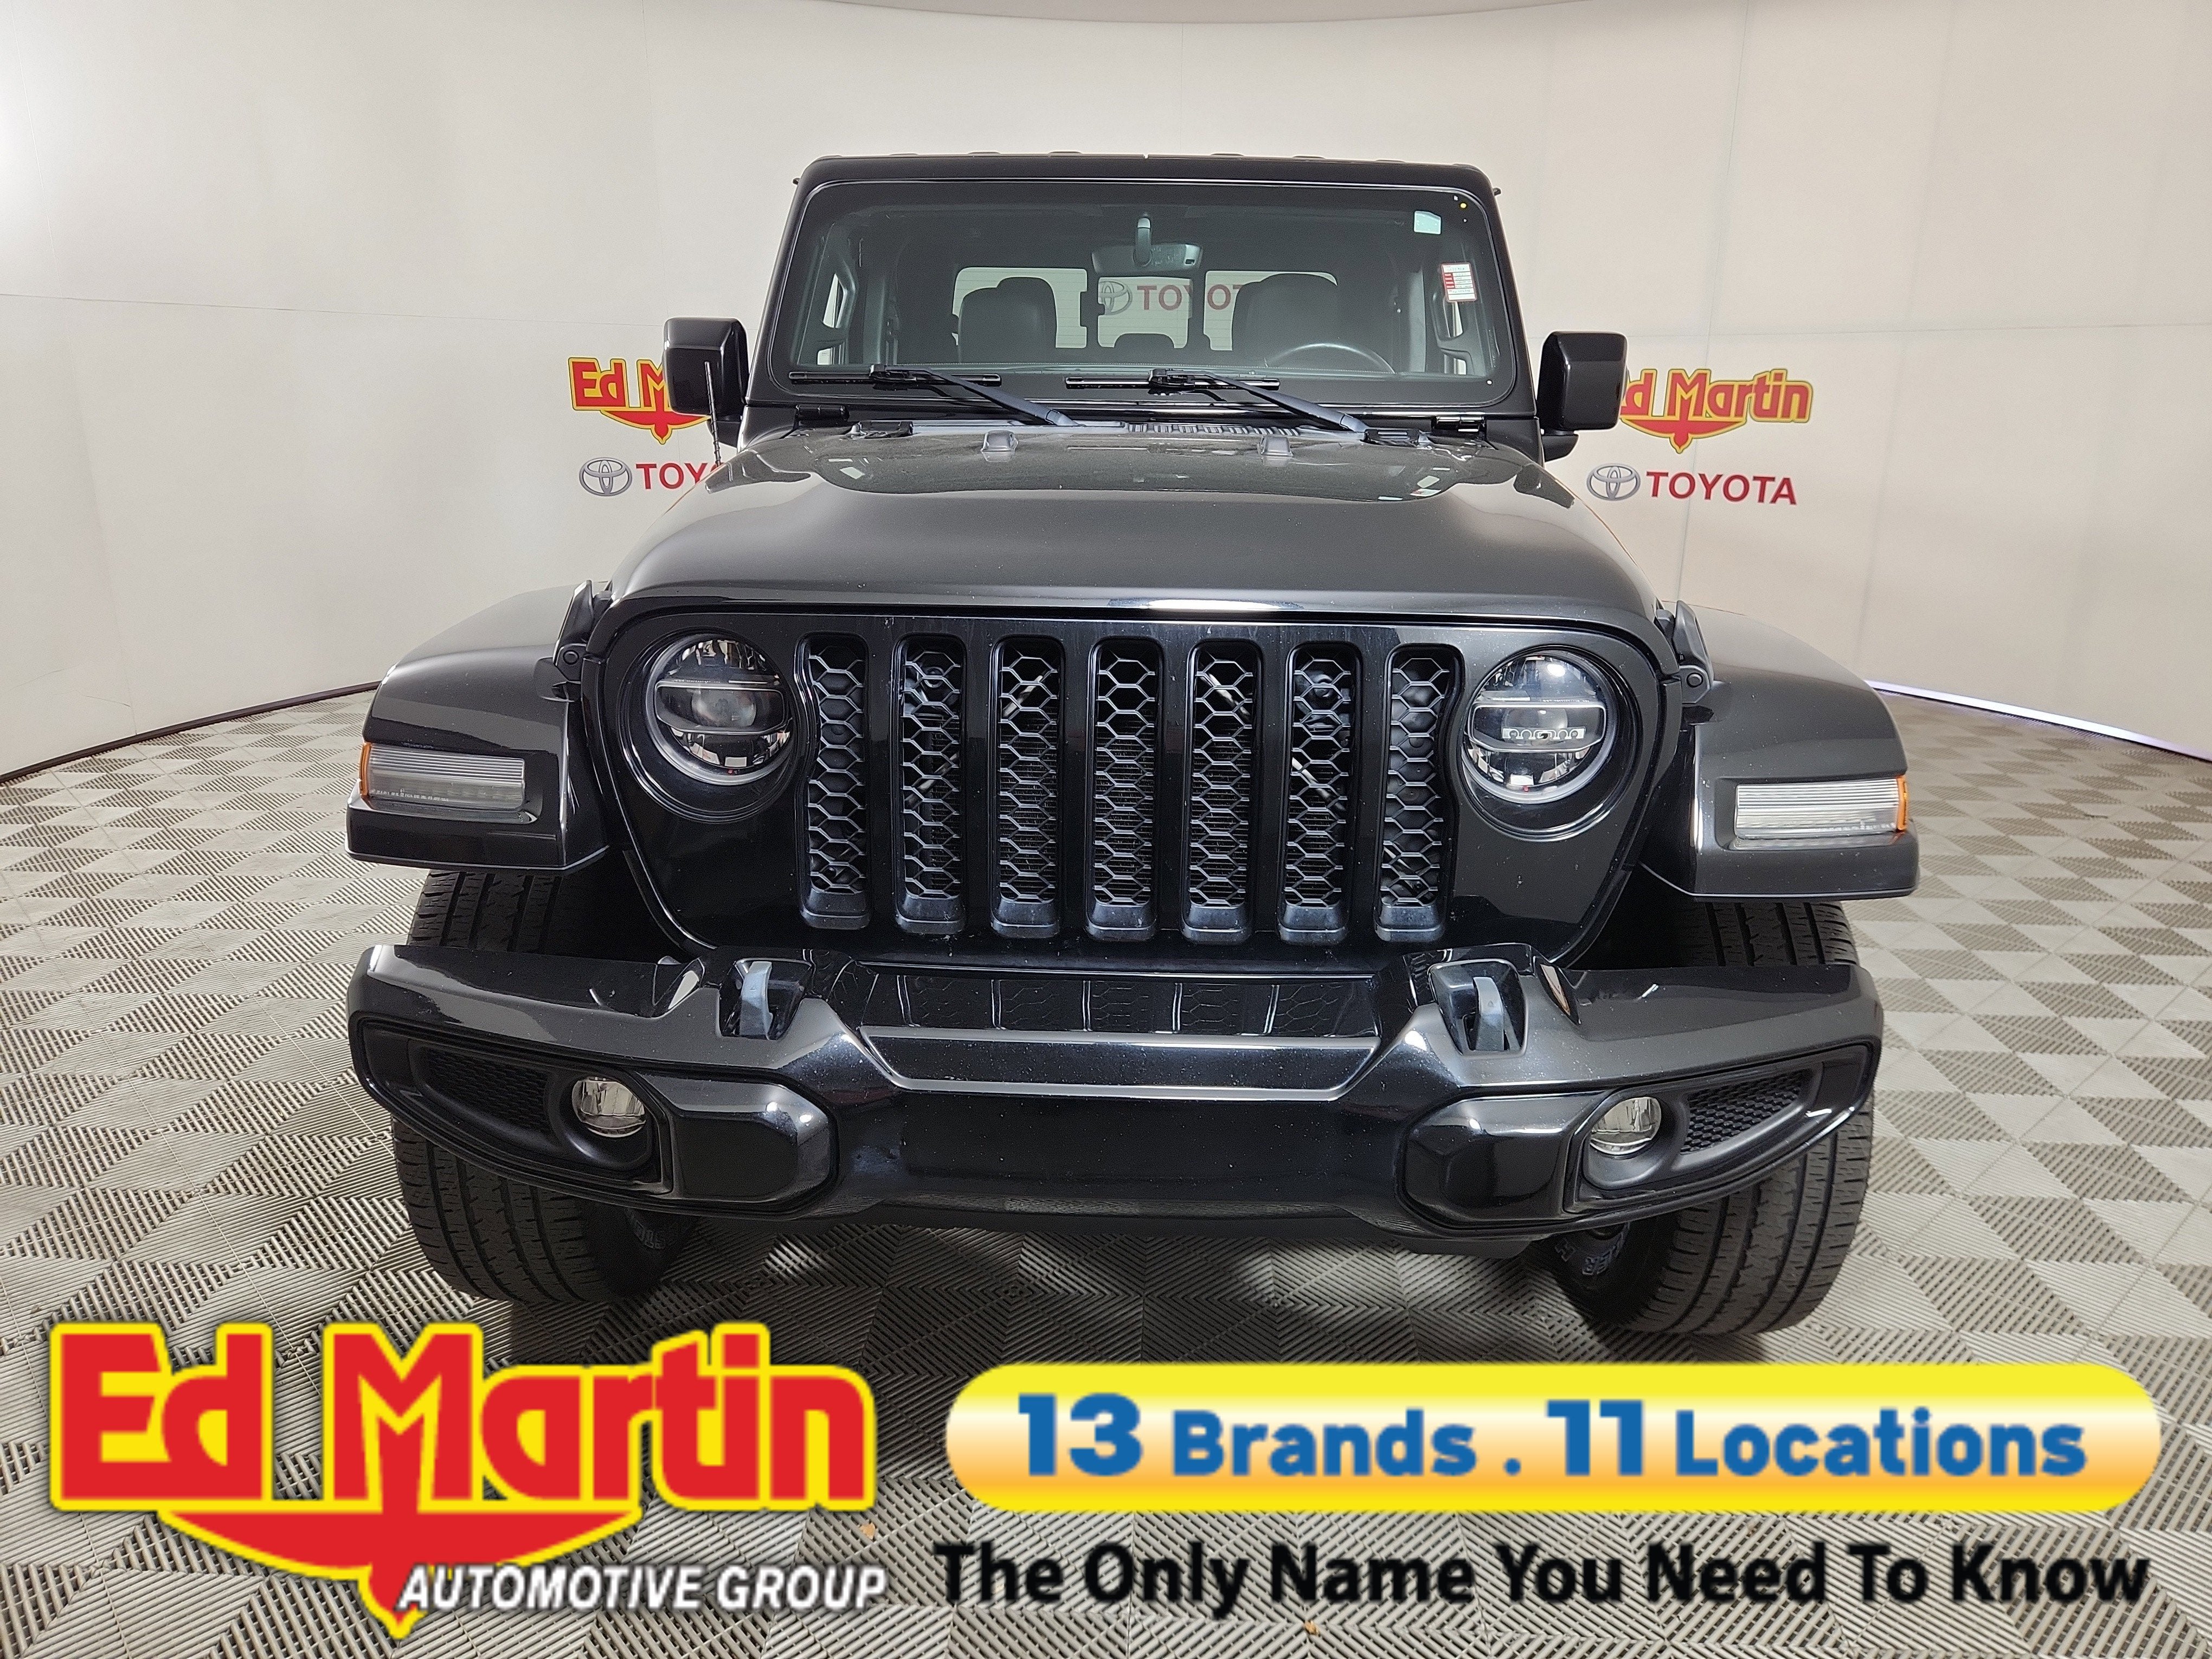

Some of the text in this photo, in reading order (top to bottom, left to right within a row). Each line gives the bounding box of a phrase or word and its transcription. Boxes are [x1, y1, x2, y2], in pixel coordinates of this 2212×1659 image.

[1137, 284, 1243, 311] TOO
[570, 358, 627, 409] Ed
[1620, 370, 1812, 421] d Martin
[635, 462, 724, 490] TOY
[1646, 471, 1797, 505] TOYOTA
